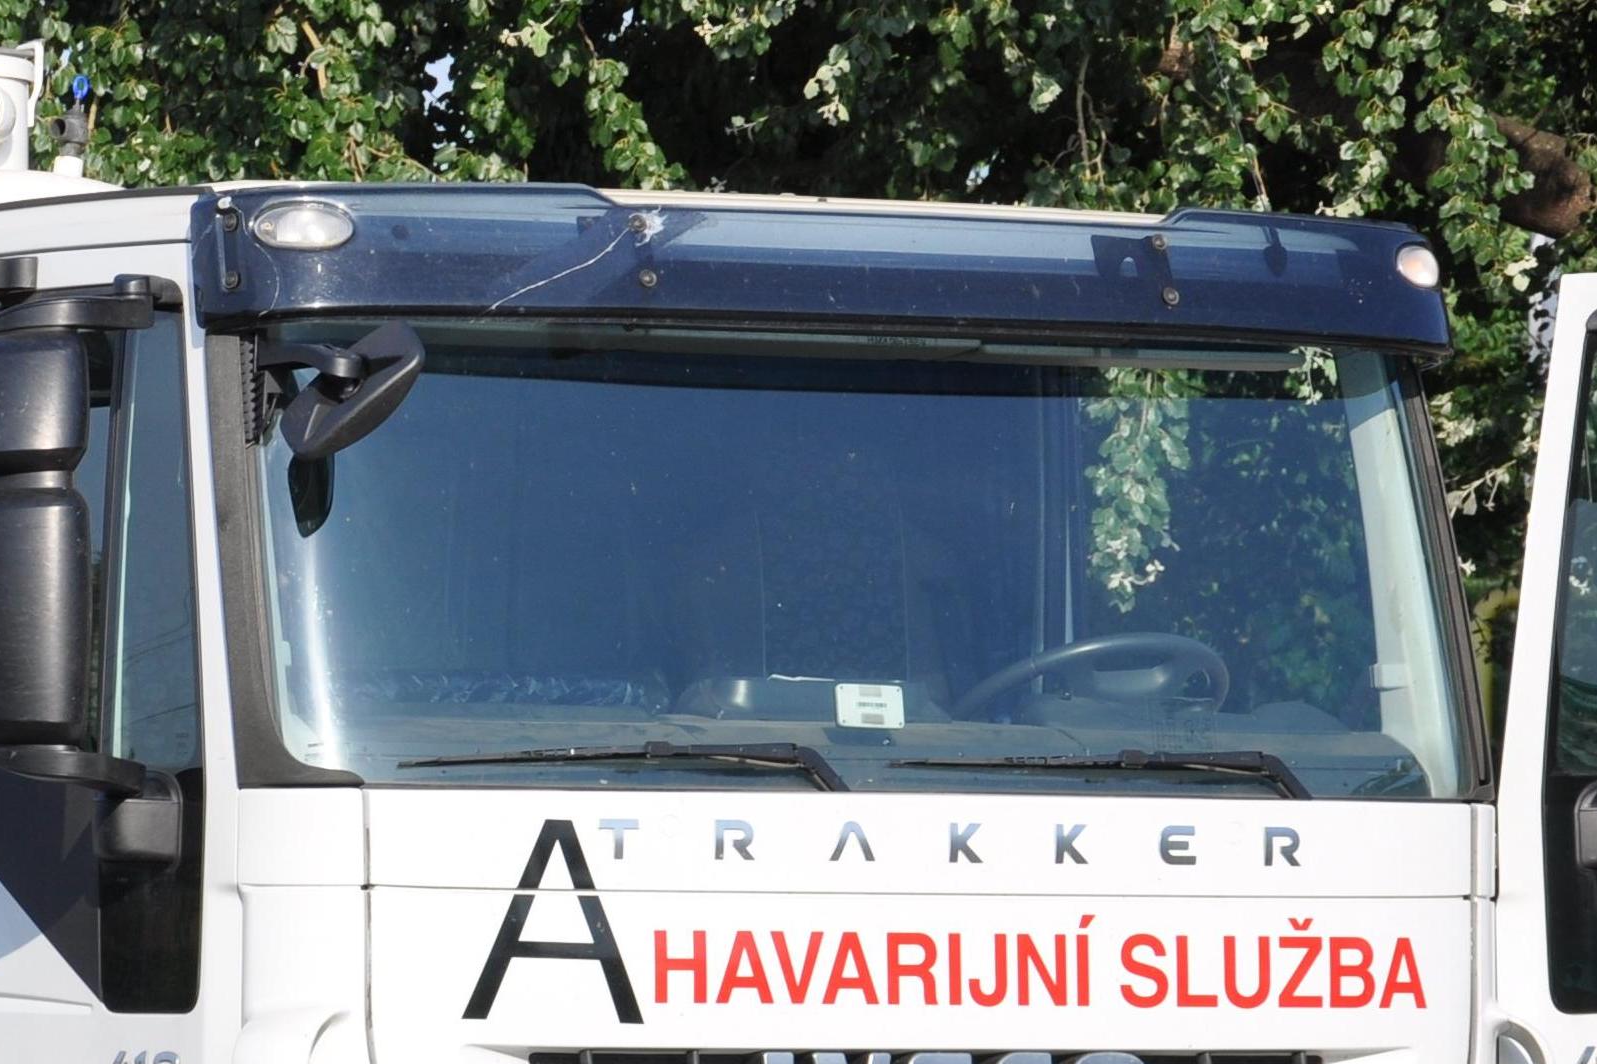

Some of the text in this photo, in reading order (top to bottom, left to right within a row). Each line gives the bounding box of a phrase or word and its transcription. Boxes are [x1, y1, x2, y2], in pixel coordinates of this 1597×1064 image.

[598, 818, 1302, 867] TRAKKER
[653, 913, 1428, 1010] HAVARIJNÍ SLUŽBA
